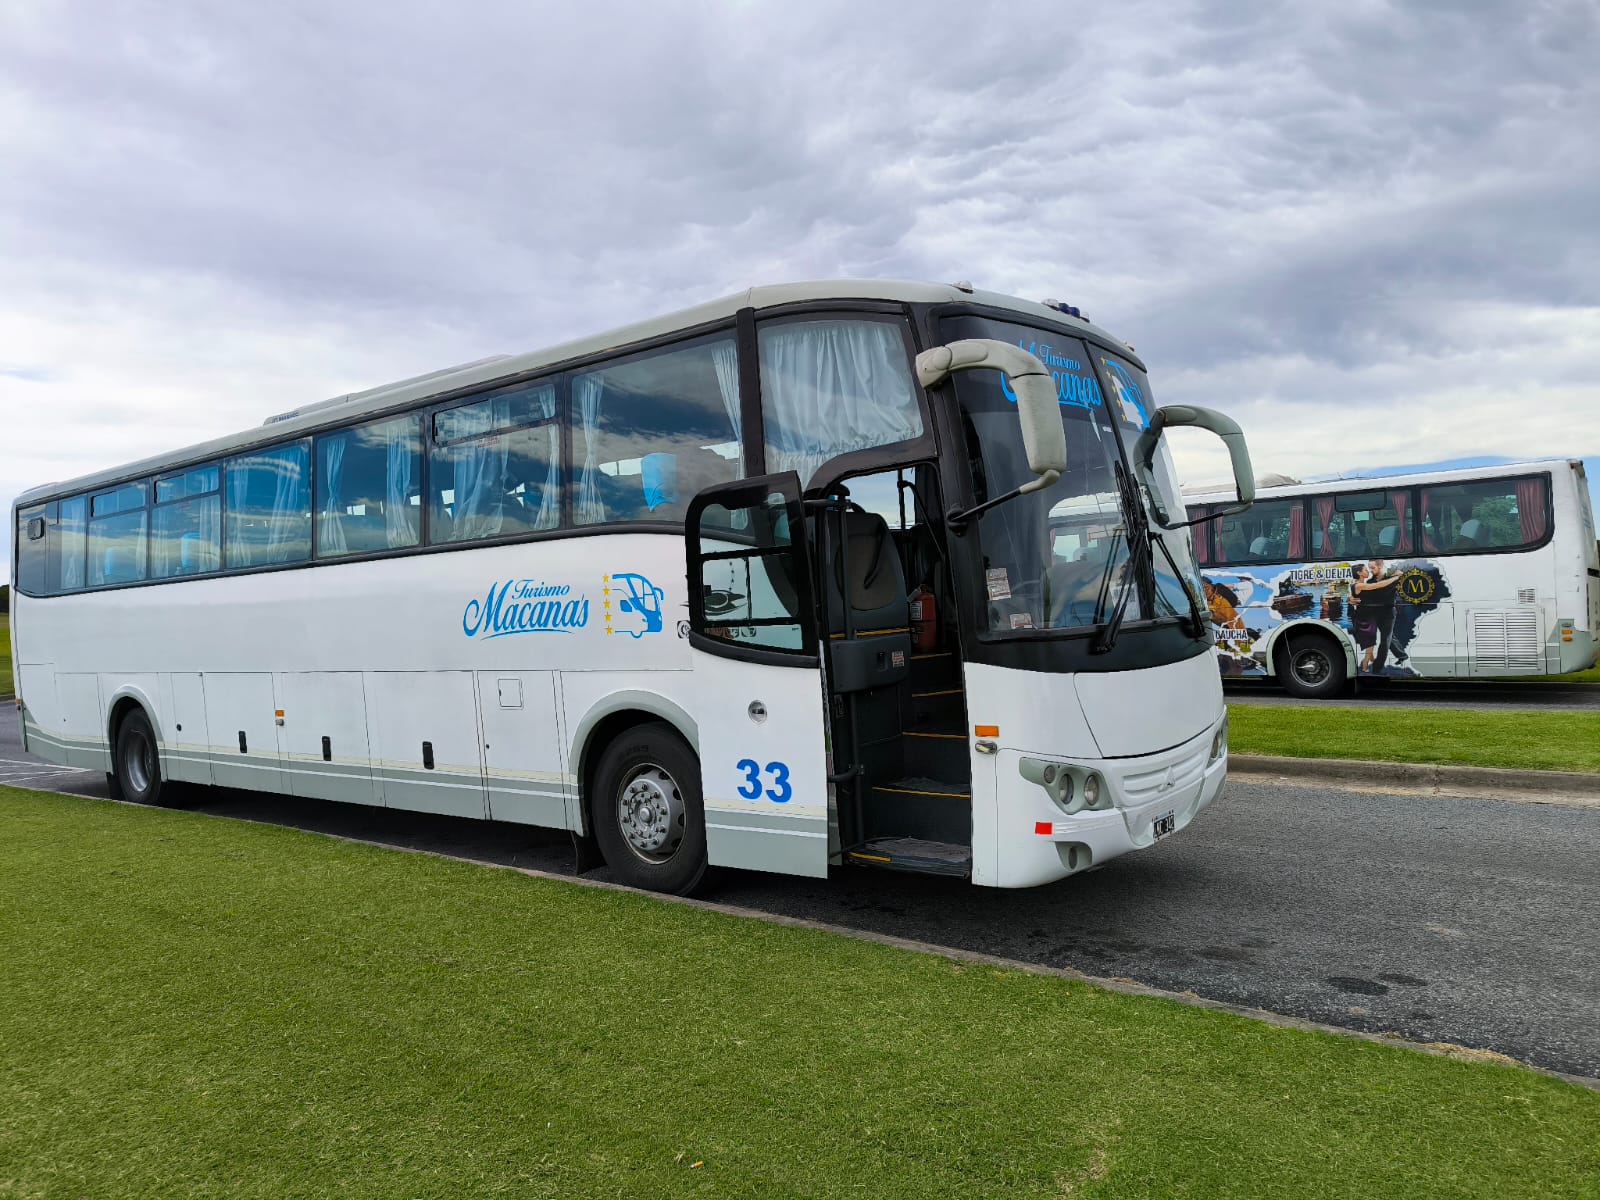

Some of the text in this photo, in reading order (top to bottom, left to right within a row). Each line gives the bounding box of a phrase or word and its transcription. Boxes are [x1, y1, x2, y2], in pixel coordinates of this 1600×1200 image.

[1039, 344, 1081, 371] Turismo
[1290, 568, 1352, 580] TIGRE & DELTA
[511, 579, 570, 600] Turismo
[1408, 579, 1424, 593] M
[736, 758, 793, 804] 33
